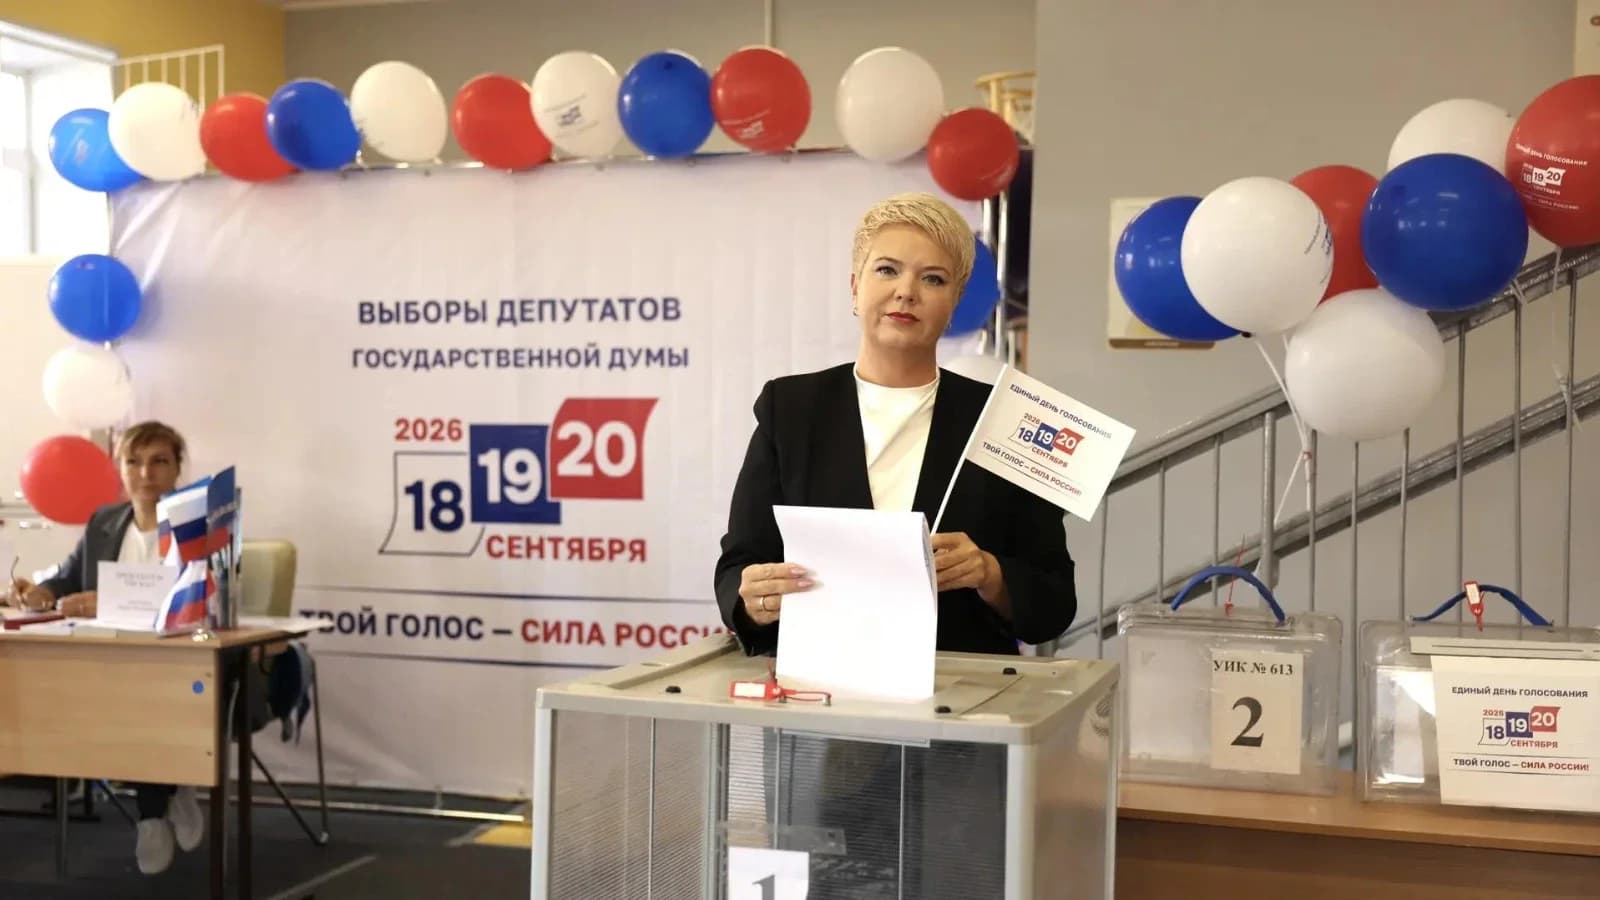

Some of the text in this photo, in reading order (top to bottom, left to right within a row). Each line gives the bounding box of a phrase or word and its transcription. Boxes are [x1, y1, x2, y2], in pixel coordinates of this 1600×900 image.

[1534, 172, 1544, 182] 19
[1546, 171, 1561, 181] 20
[358, 297, 681, 327] ВЫБОРЫ ДЕПУТАТОВ
[352, 342, 690, 371] ГОСУДАРСТВЕННОЙ ДУМЫ
[1009, 383, 1041, 403] ЕДИНЫЙ
[1039, 399, 1059, 414] ДЕНЬ
[394, 418, 463, 441] 2026
[1017, 427, 1077, 450] 18 19 20
[982, 441, 1001, 456] ТВОЙ
[1000, 450, 1025, 468] ГОЛОС
[1030, 466, 1050, 481] СИЛА
[1031, 446, 1069, 468] СЕНТЯБРЯ
[404, 421, 637, 532] 18 19 20
[486, 535, 647, 562] СЕНТЯБРЯ
[386, 613, 484, 641] ГОЛОС
[521, 618, 605, 646] СИЛА
[1213, 660, 1293, 675] УИК № 613
[1451, 686, 1588, 698] ЕДИНЫЙ ДЕНЬ ГОЛОСОВАНИЯ
[1230, 696, 1264, 747] 2
[1485, 712, 1555, 739] 18 19 20
[1510, 740, 1558, 749] СЕНТЯБРЯ
[1453, 757, 1478, 767] ТВОЙ
[1480, 759, 1510, 768] ГОЛОС
[1521, 761, 1546, 769] СИЛА
[1548, 762, 1589, 772] РОССИИ!
